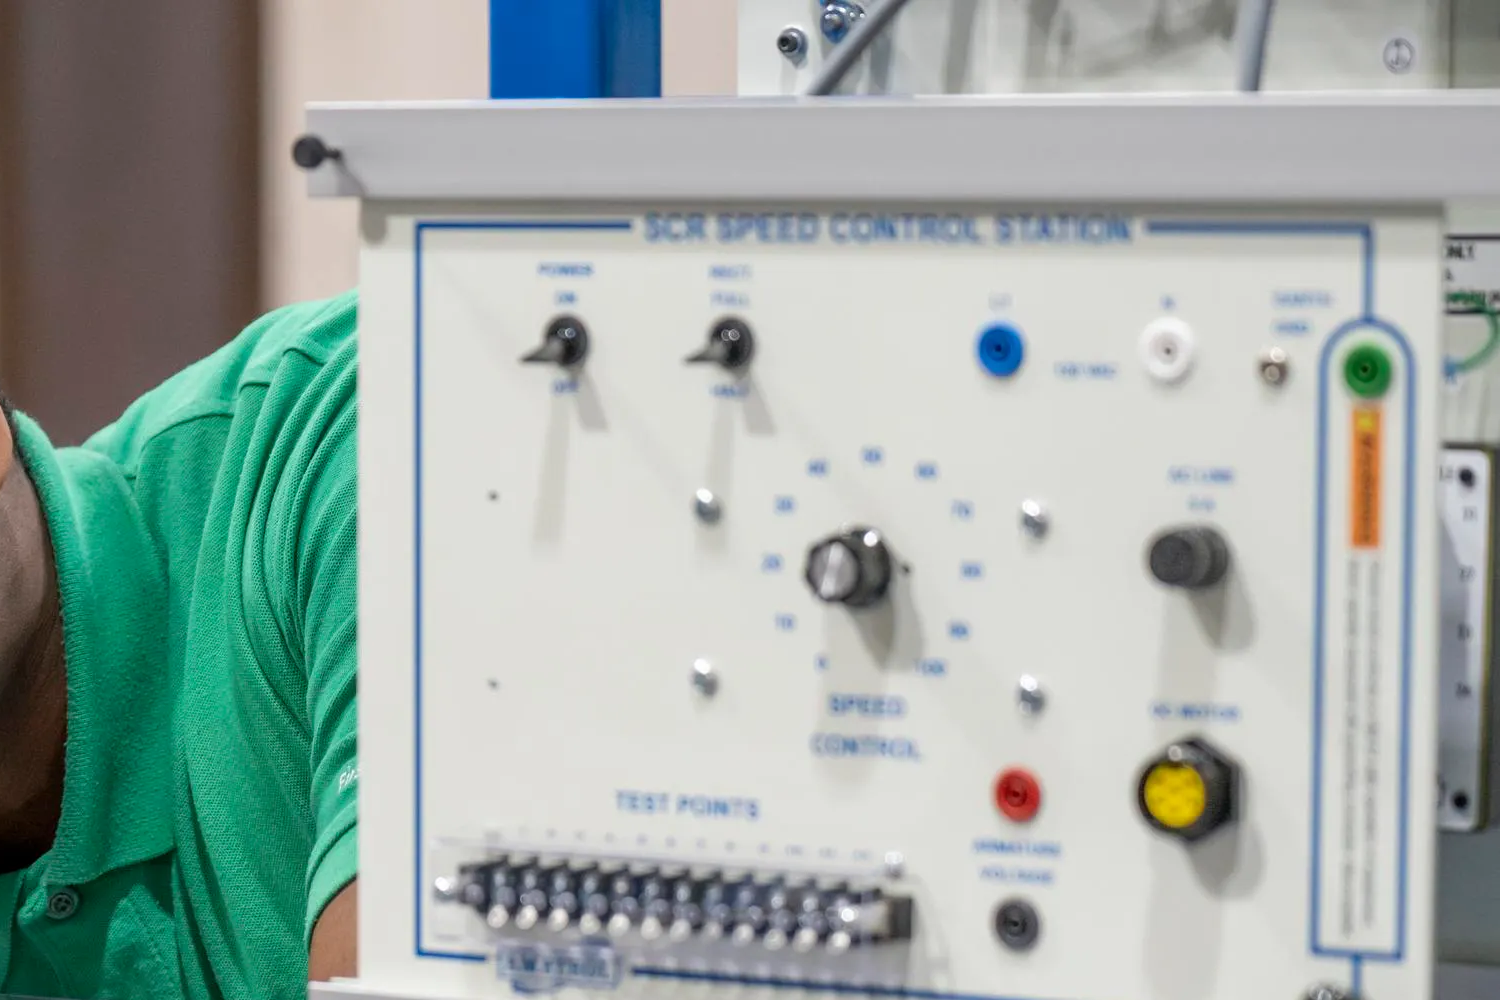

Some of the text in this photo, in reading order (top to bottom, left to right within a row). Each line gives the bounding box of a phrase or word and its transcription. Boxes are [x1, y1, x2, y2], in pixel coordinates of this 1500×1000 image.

[644, 212, 1133, 245] SCR SPEED CONTROL STATION
[829, 693, 907, 718] SPEED
[810, 733, 922, 762] CONTROL
[615, 790, 760, 821] TEST POINTS
